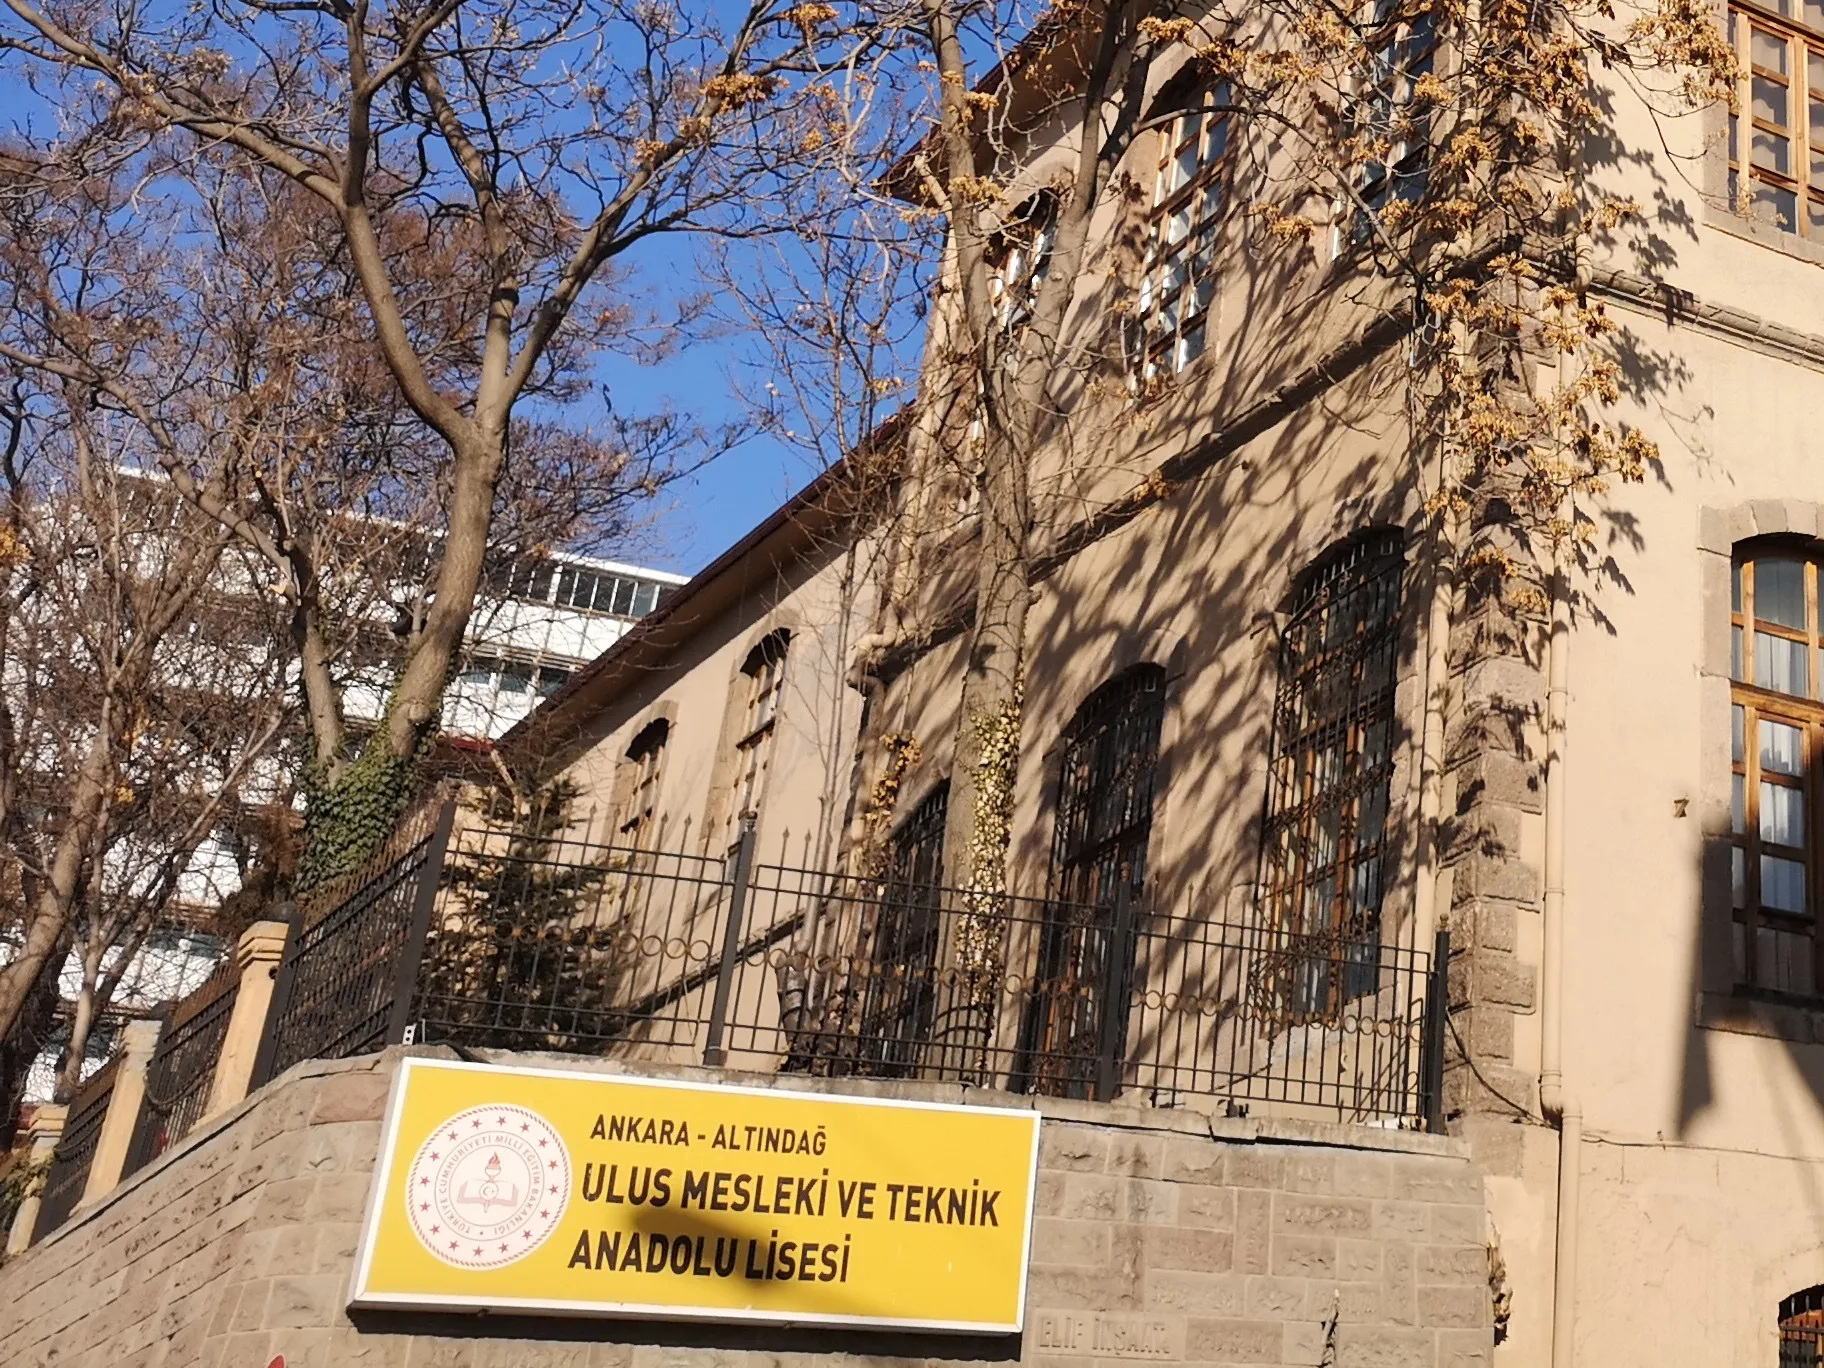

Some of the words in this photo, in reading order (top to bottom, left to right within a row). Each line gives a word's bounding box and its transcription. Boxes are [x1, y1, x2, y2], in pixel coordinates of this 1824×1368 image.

[590, 1114, 690, 1146] ANKARA
[711, 1124, 827, 1156] ALTINDAĞ
[582, 1163, 672, 1207] ULUS
[681, 1168, 829, 1216] MESLEKİ
[838, 1180, 877, 1220] VE
[886, 1179, 1002, 1227] TEKNİK
[567, 1229, 738, 1278] ANADOLU
[745, 1229, 851, 1283] LİSESİ
